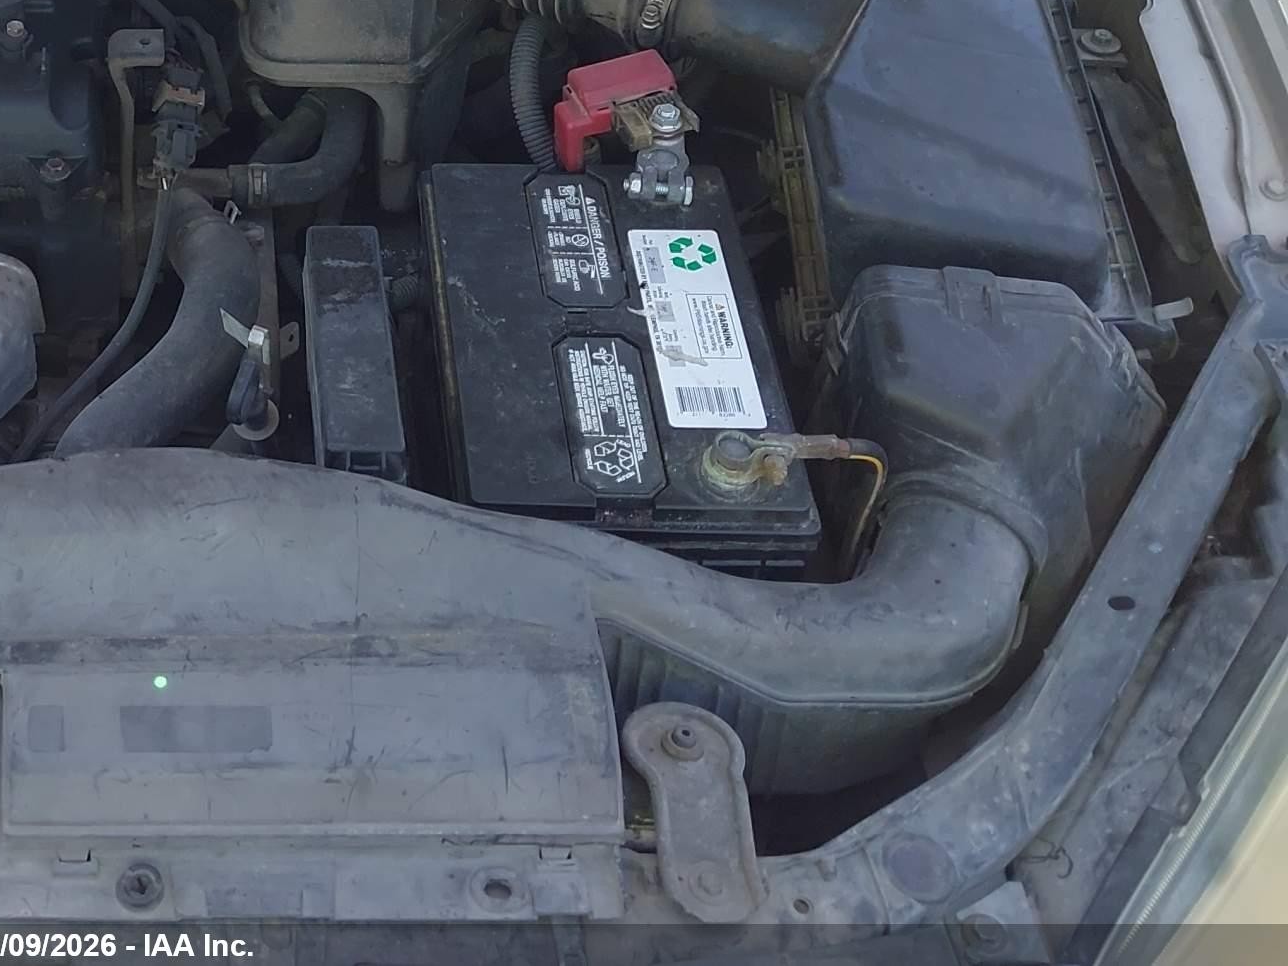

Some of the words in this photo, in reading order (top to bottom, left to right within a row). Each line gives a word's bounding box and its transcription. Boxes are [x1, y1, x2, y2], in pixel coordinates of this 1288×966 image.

[586, 206, 602, 238] DANGER
[595, 247, 610, 277] POISON
[717, 311, 734, 348] WARNING:
[592, 364, 602, 385] MEDICAL
[600, 365, 608, 377] WITH
[606, 397, 614, 406] GET
[607, 365, 616, 380] FLUSH
[596, 386, 605, 399] HELP
[610, 382, 619, 393] EYES
[613, 395, 625, 426] IMMEDIATELY
